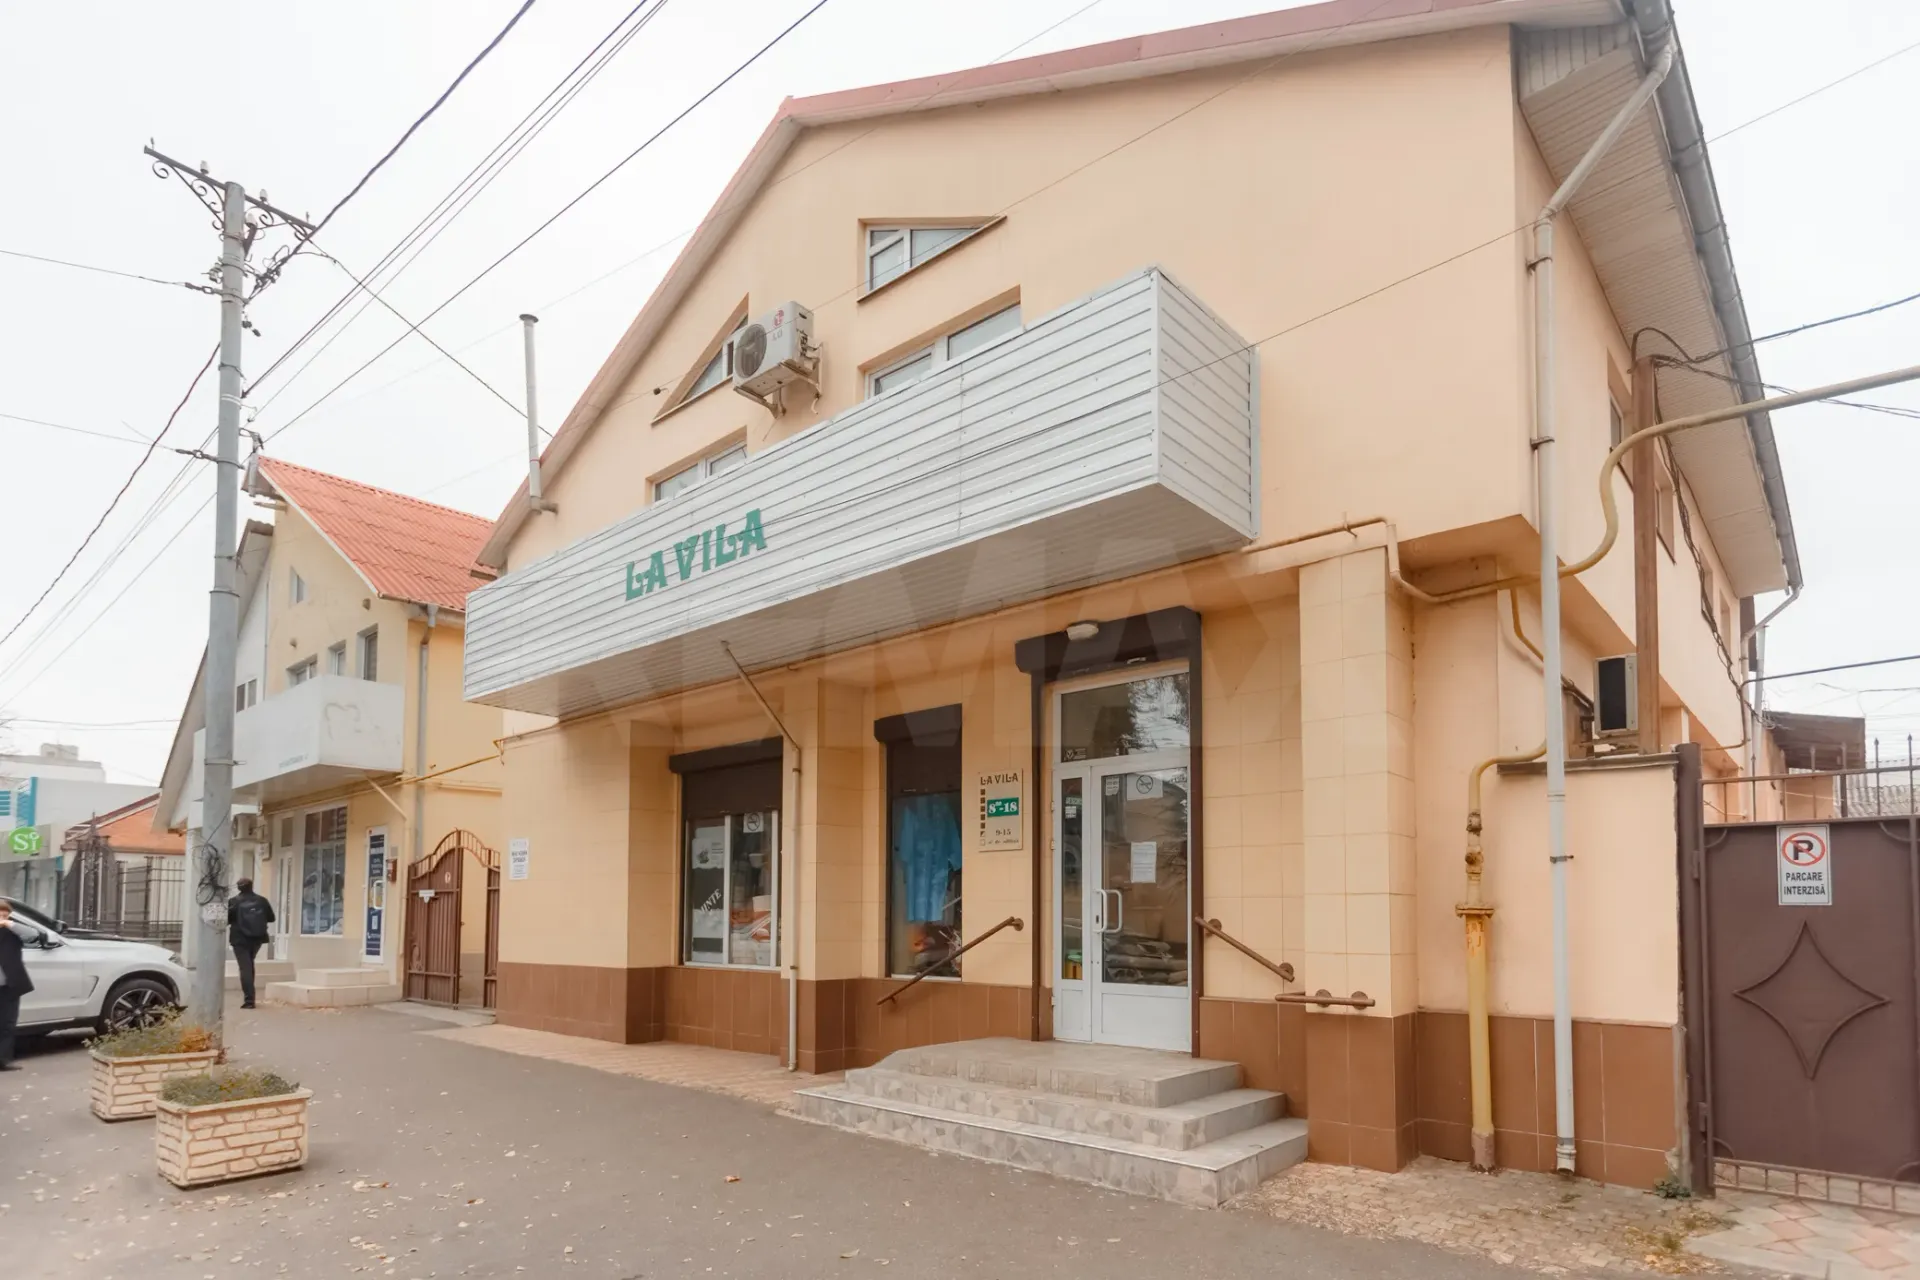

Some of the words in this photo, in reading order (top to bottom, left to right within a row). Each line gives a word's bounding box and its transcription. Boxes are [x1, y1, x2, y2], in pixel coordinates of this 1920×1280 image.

[625, 550, 668, 602] LA
[673, 508, 768, 582] VILA
[980, 776, 993, 786] LA
[994, 772, 1019, 784] VILA
[1785, 871, 1823, 882] PARCARE
[1783, 883, 1826, 896] INTERZISĂ
